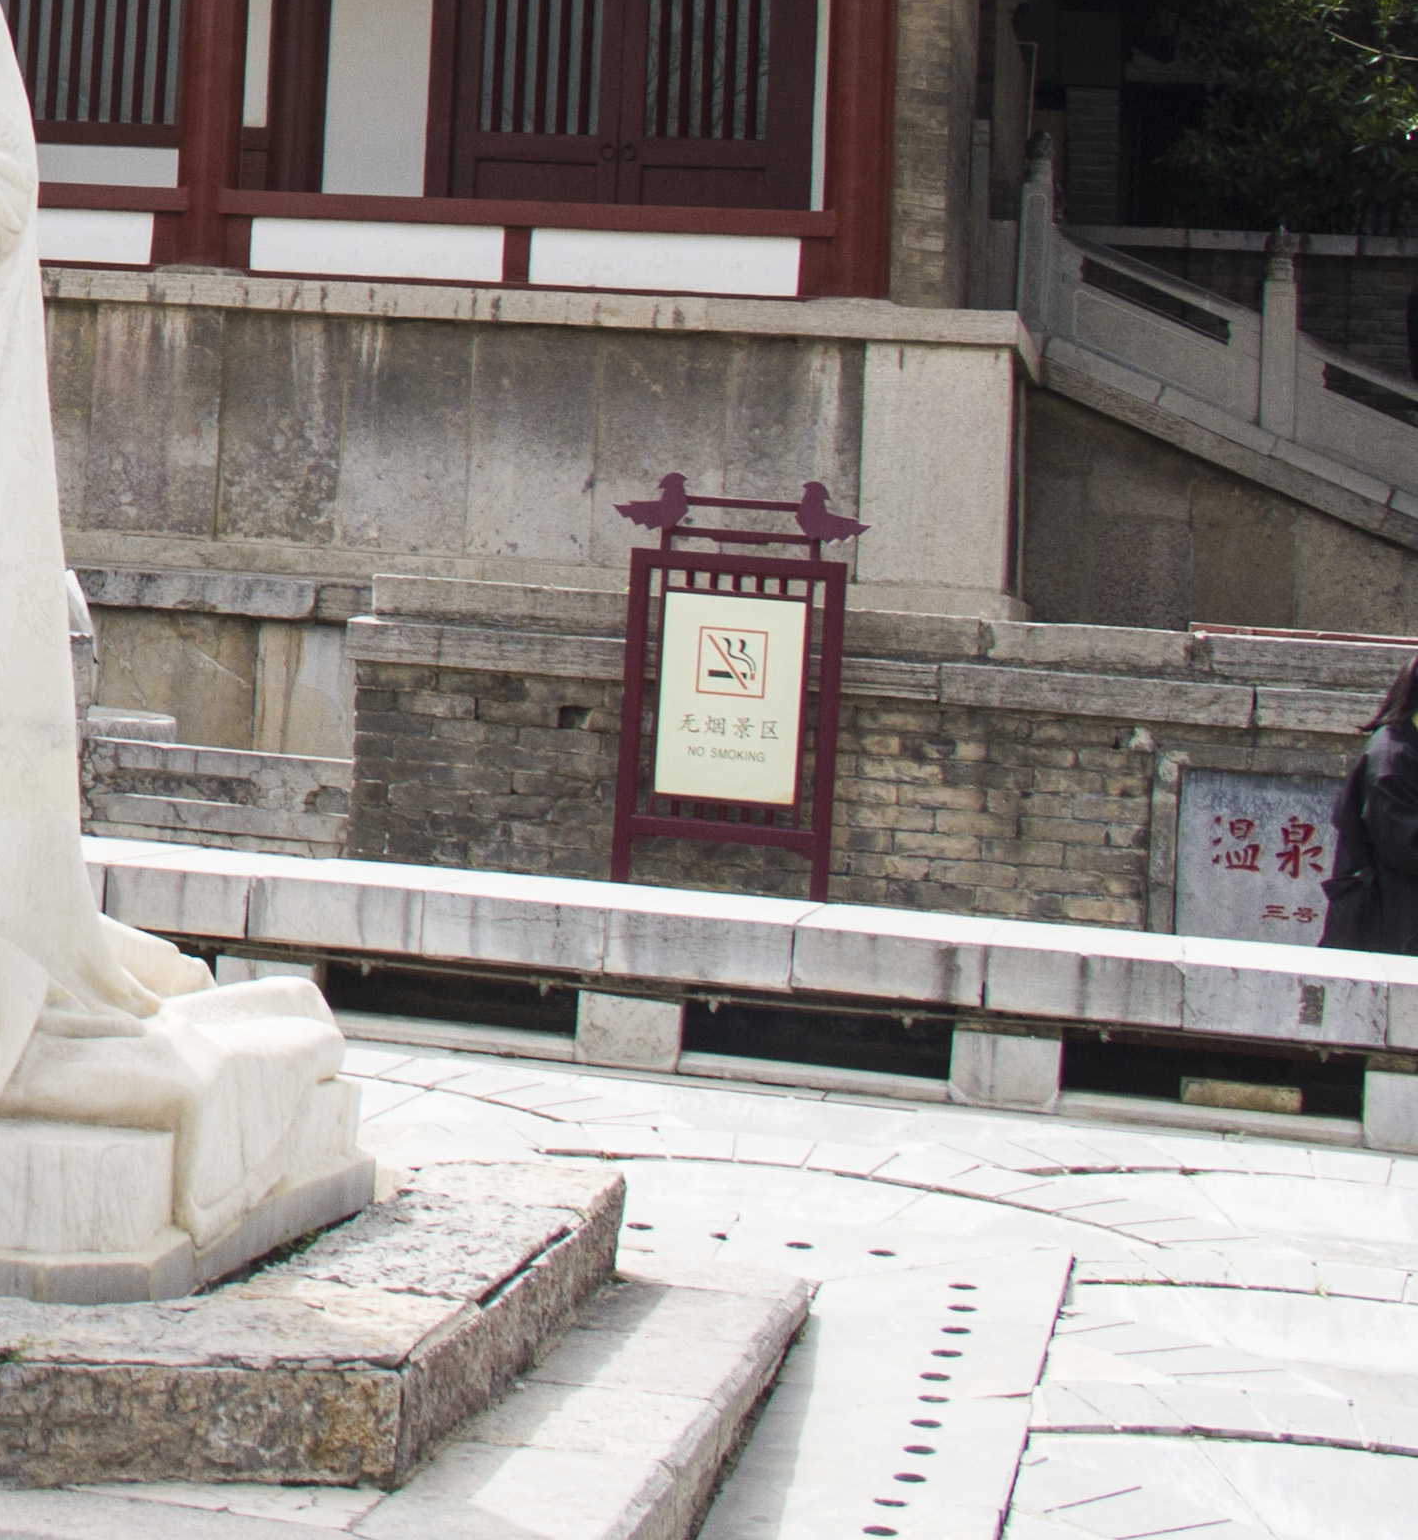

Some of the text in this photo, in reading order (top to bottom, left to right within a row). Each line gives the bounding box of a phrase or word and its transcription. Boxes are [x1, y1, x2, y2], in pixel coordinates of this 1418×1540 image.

[676, 713, 779, 740] 无烟景区
[687, 745, 766, 763] NO SMOKING
[1211, 815, 1324, 879] 温泉
[1261, 904, 1318, 923] 三号
